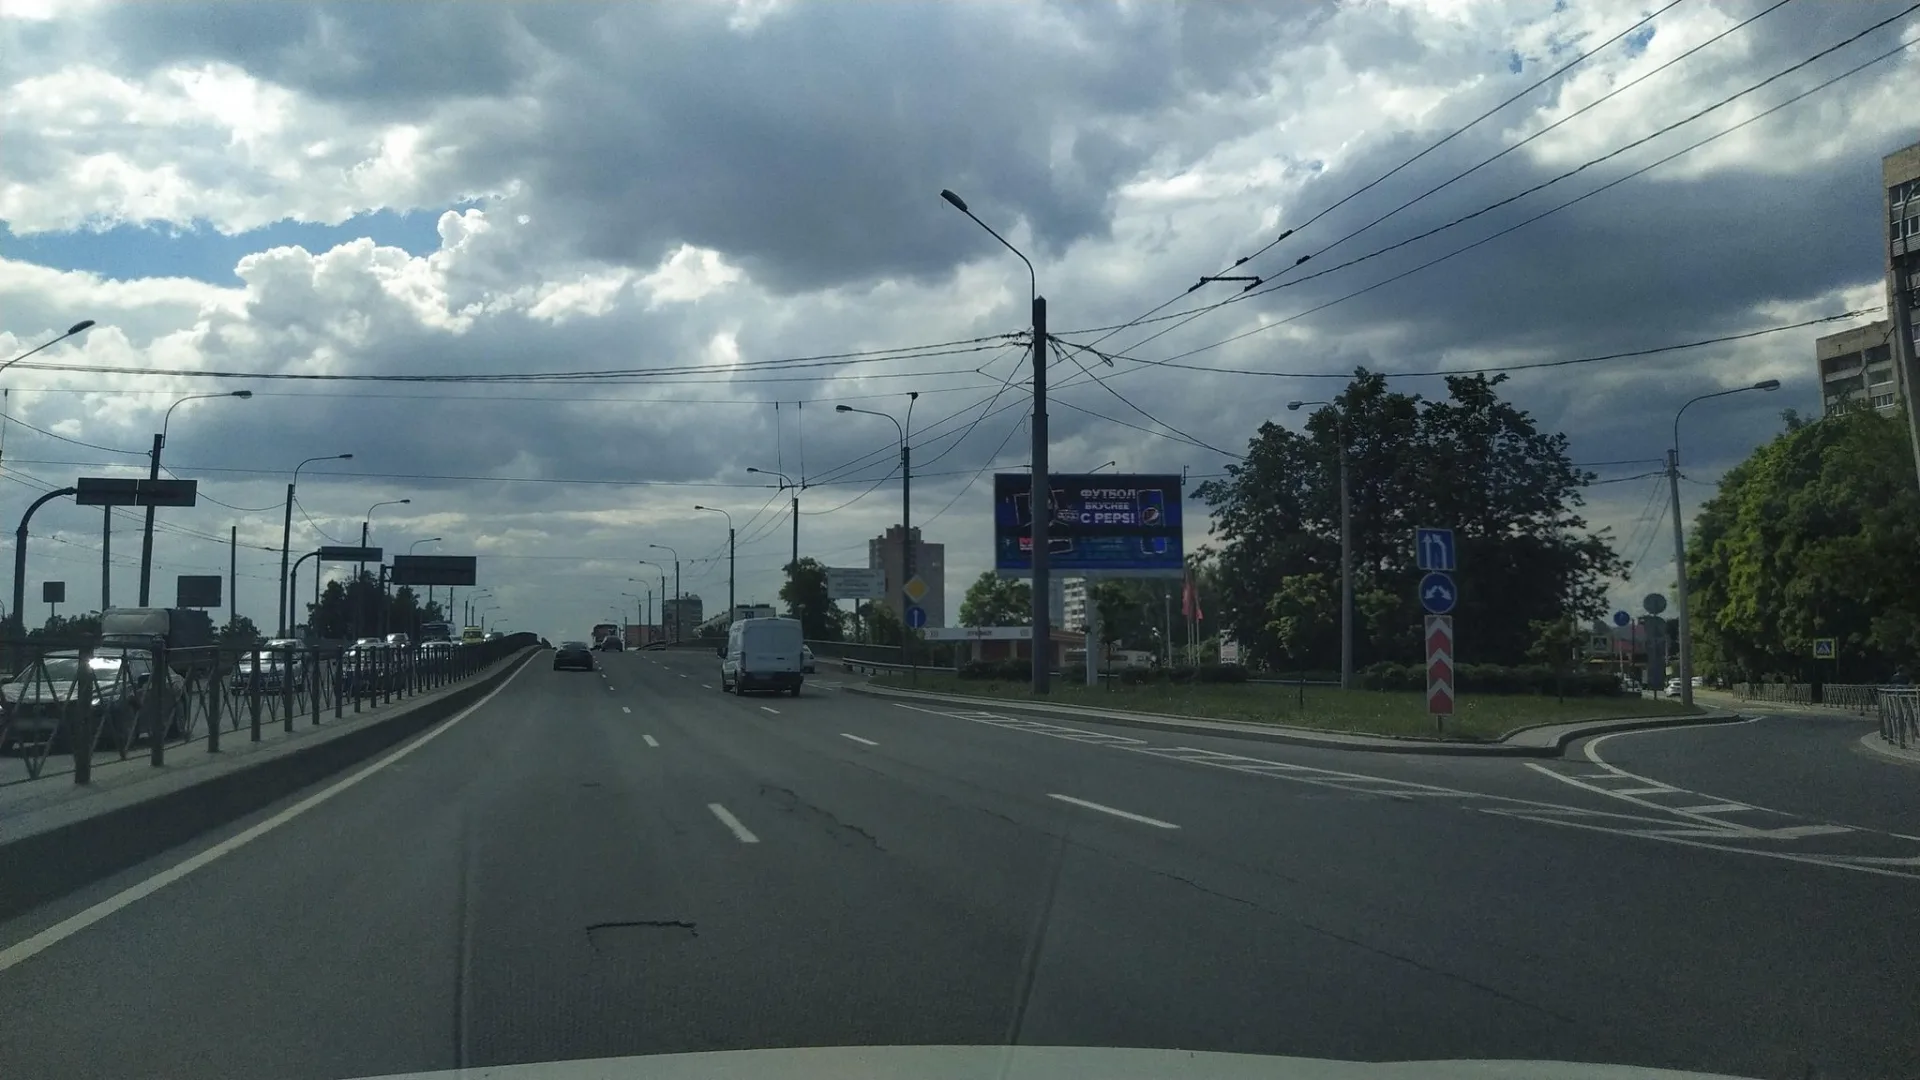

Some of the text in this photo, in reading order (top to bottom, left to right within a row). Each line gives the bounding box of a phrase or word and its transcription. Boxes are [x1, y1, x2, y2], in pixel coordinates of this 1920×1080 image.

[1080, 489, 1136, 499] ФУТБОЛ
[1085, 502, 1130, 510] ВКУСНЕЕ
[1095, 513, 1135, 523] PEPSI
